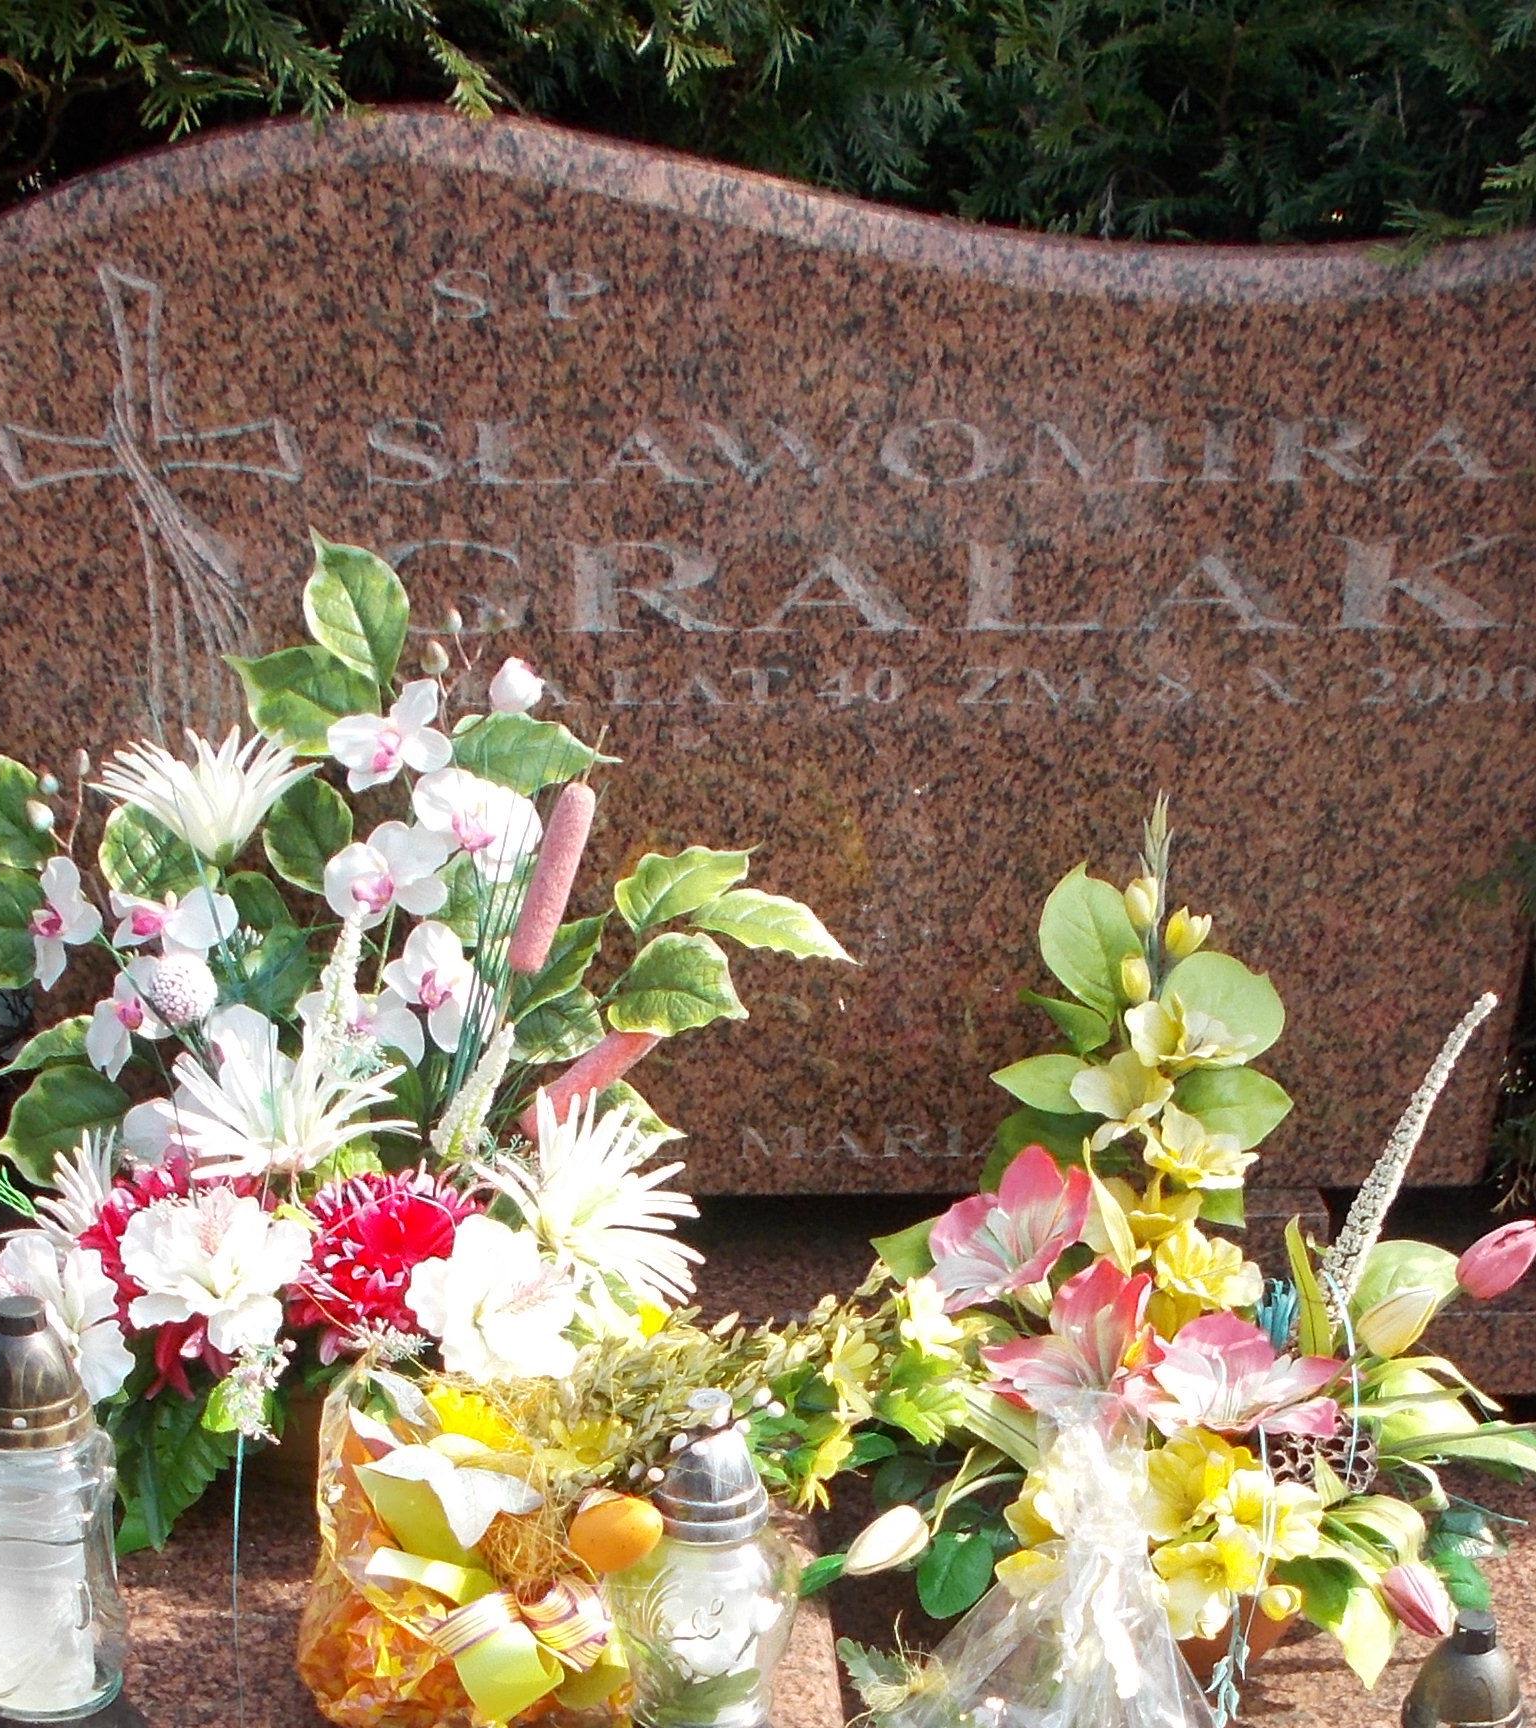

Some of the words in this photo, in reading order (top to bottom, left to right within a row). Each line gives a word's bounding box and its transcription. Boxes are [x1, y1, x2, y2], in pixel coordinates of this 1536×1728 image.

[546, 270, 610, 321] P
[382, 533, 1522, 633] GRALAK
[607, 665, 791, 707] LAT
[815, 665, 906, 707] 40
[737, 1122, 999, 1161] MARI
